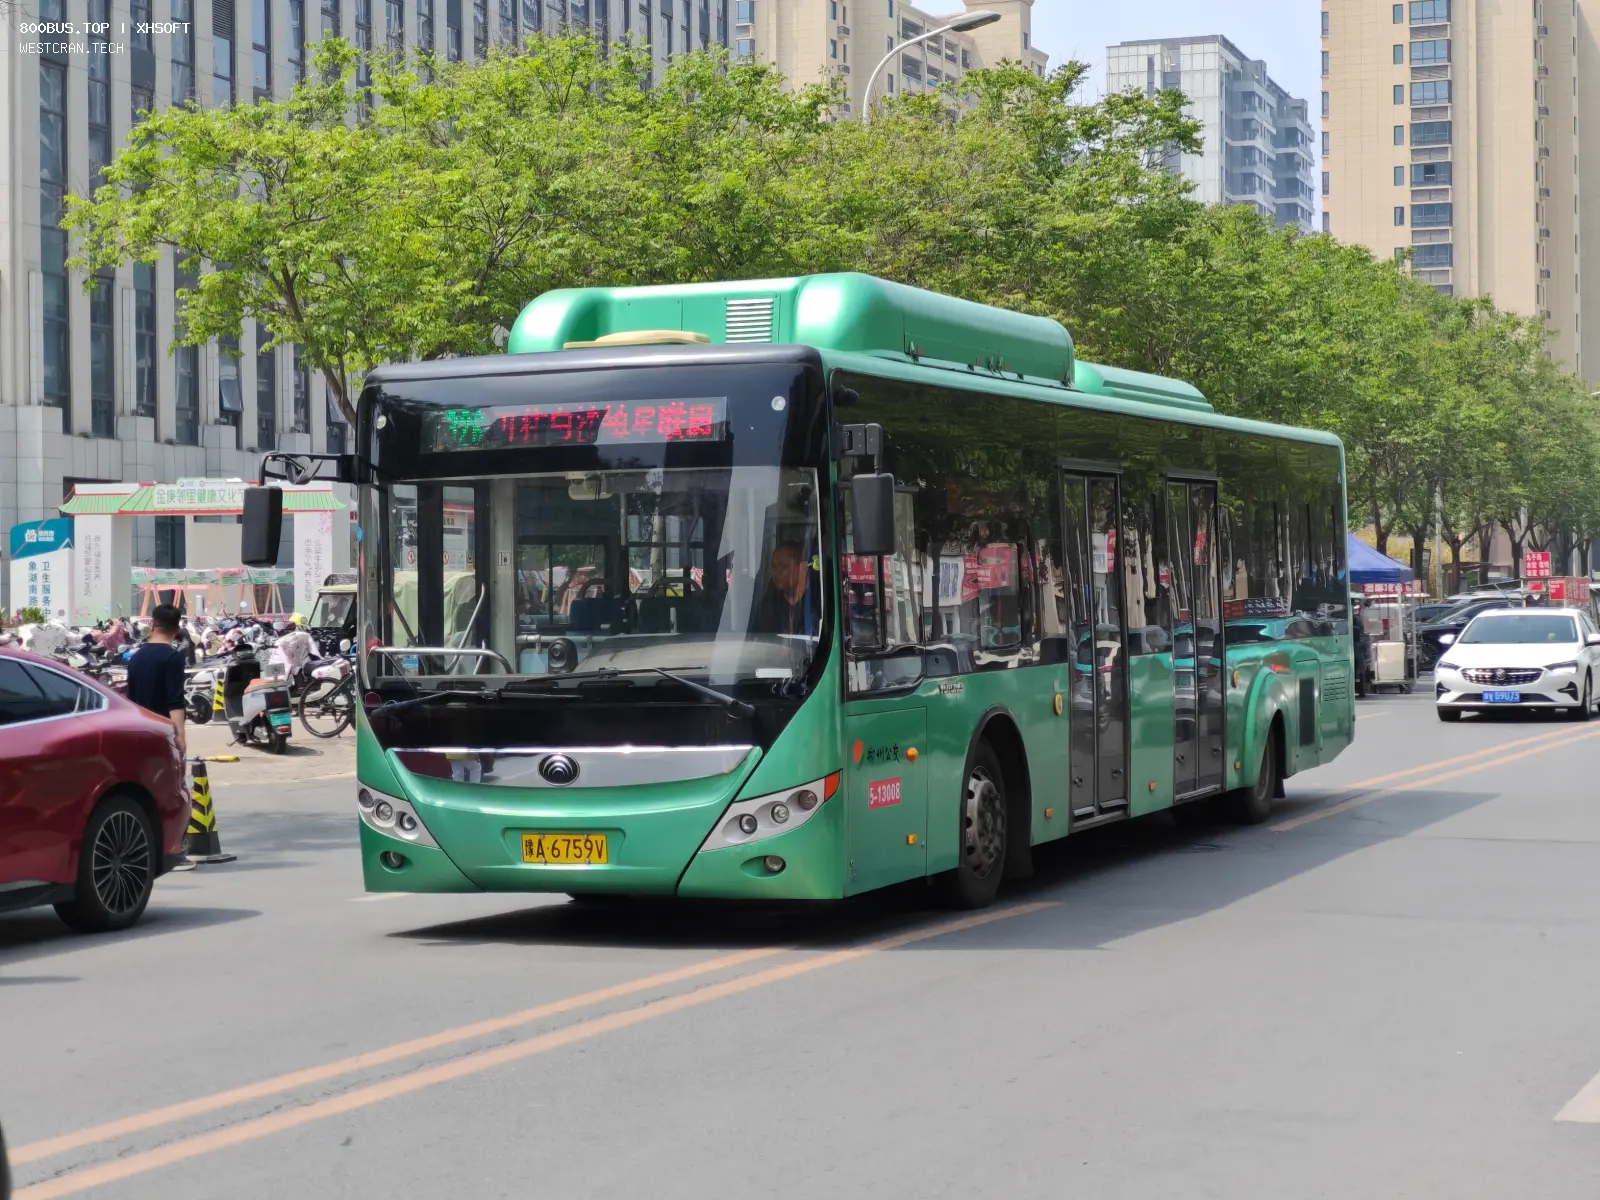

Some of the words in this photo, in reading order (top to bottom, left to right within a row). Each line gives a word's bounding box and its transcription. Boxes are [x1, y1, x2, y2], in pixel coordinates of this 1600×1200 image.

[42, 562, 50, 622] 卫生服务中
[867, 744, 900, 763] 郑州公交
[869, 782, 900, 805] 5-13008
